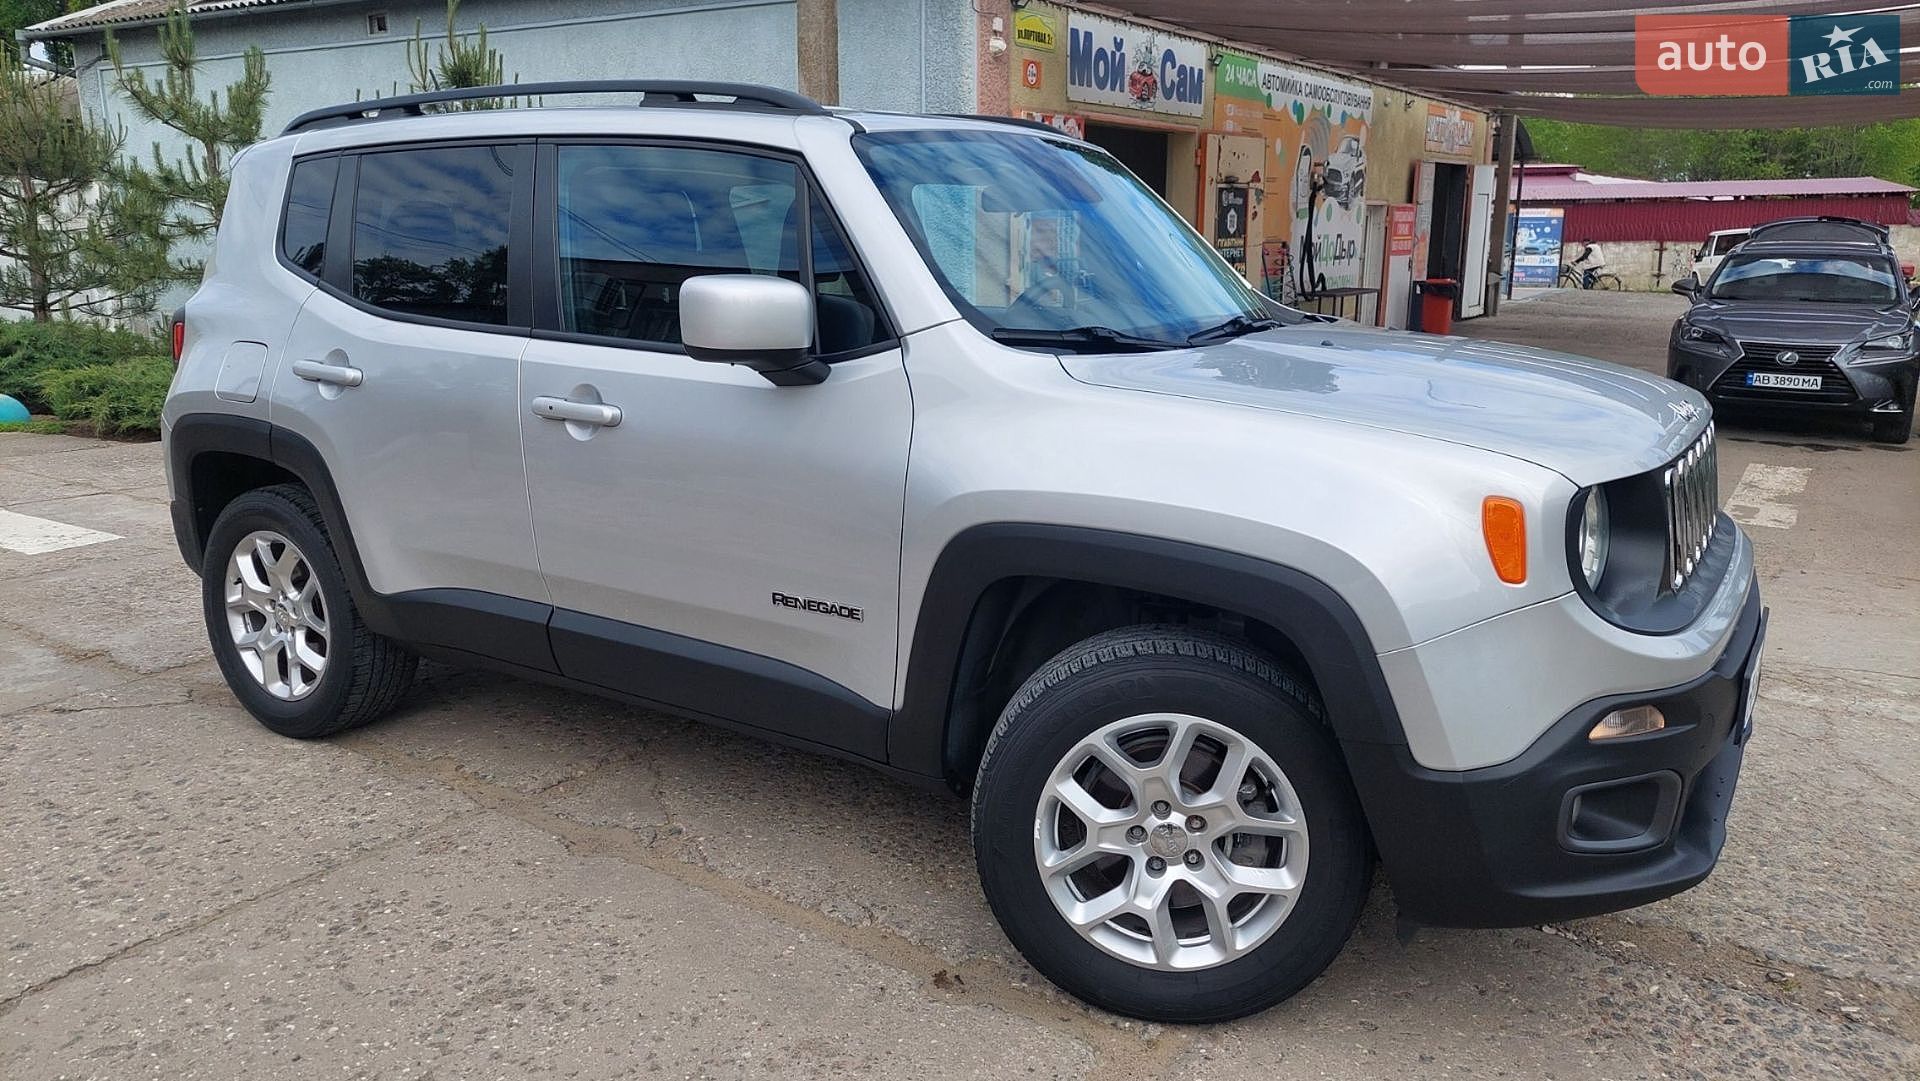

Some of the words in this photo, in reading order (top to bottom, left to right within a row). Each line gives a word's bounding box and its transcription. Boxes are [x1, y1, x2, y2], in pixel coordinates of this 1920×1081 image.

[1069, 27, 1126, 93] Мой
[1160, 48, 1204, 105] Сам
[1224, 63, 1235, 83] 24
[1235, 65, 1257, 88] ЧАСА
[1261, 73, 1303, 96] АВТОМИЙКА
[1753, 374, 1770, 385] AB
[1772, 375, 1800, 387] 3890
[1801, 377, 1819, 388] MA
[772, 592, 864, 622] RENEGADE
